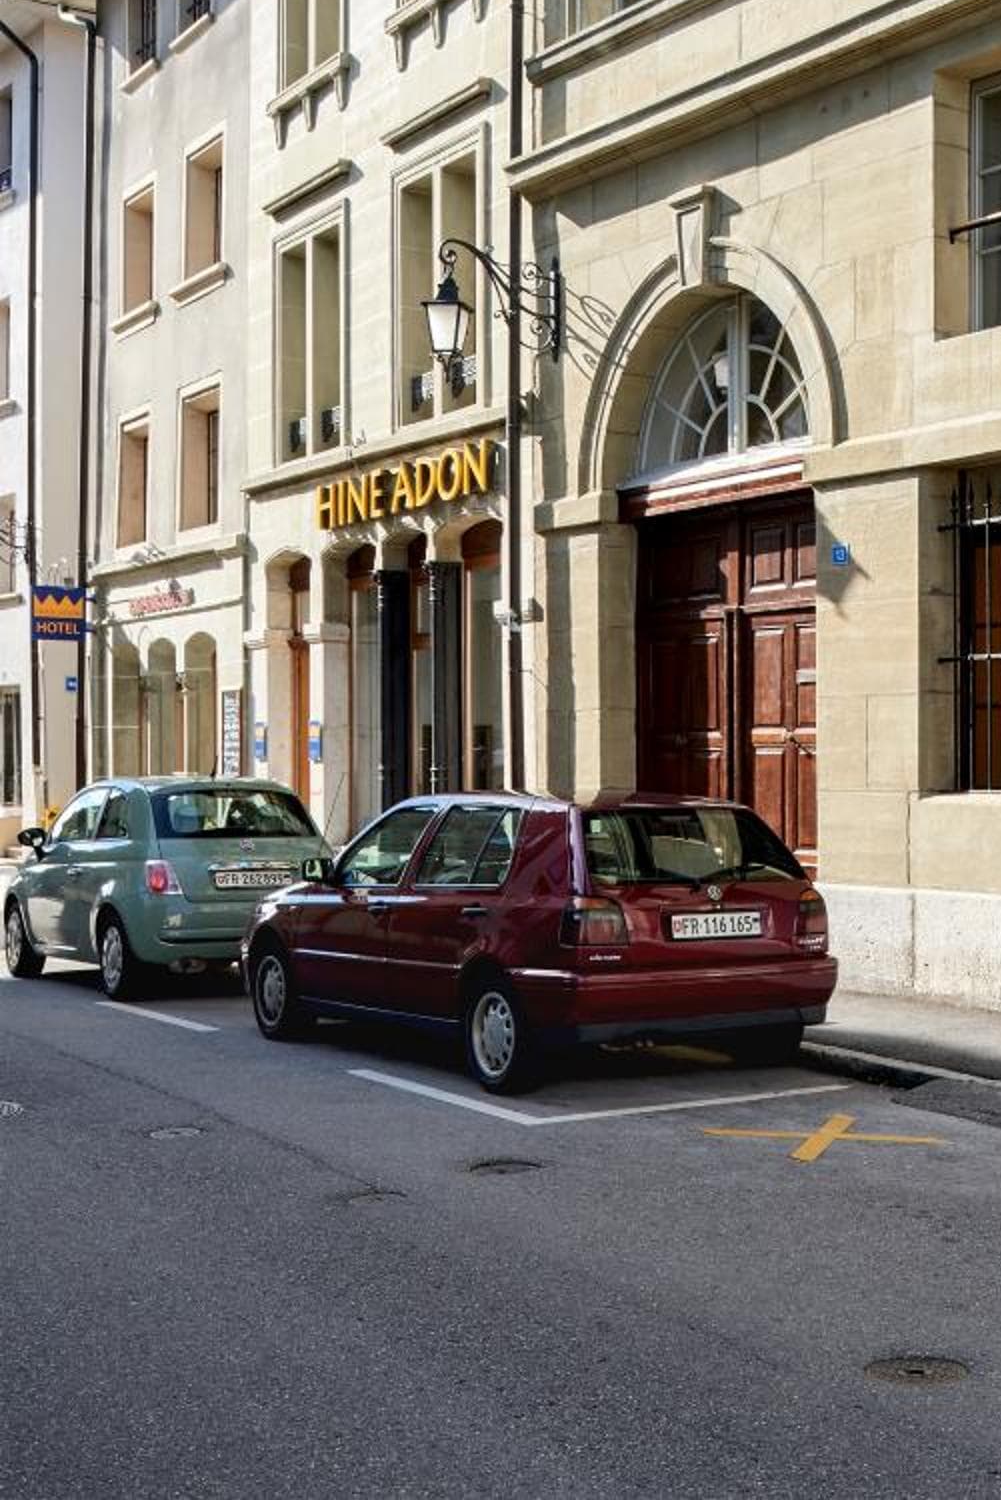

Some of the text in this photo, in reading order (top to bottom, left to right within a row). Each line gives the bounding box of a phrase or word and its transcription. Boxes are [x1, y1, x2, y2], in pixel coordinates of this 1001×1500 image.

[316, 437, 489, 530] HINE ADON
[37, 621, 80, 635] HOTEL
